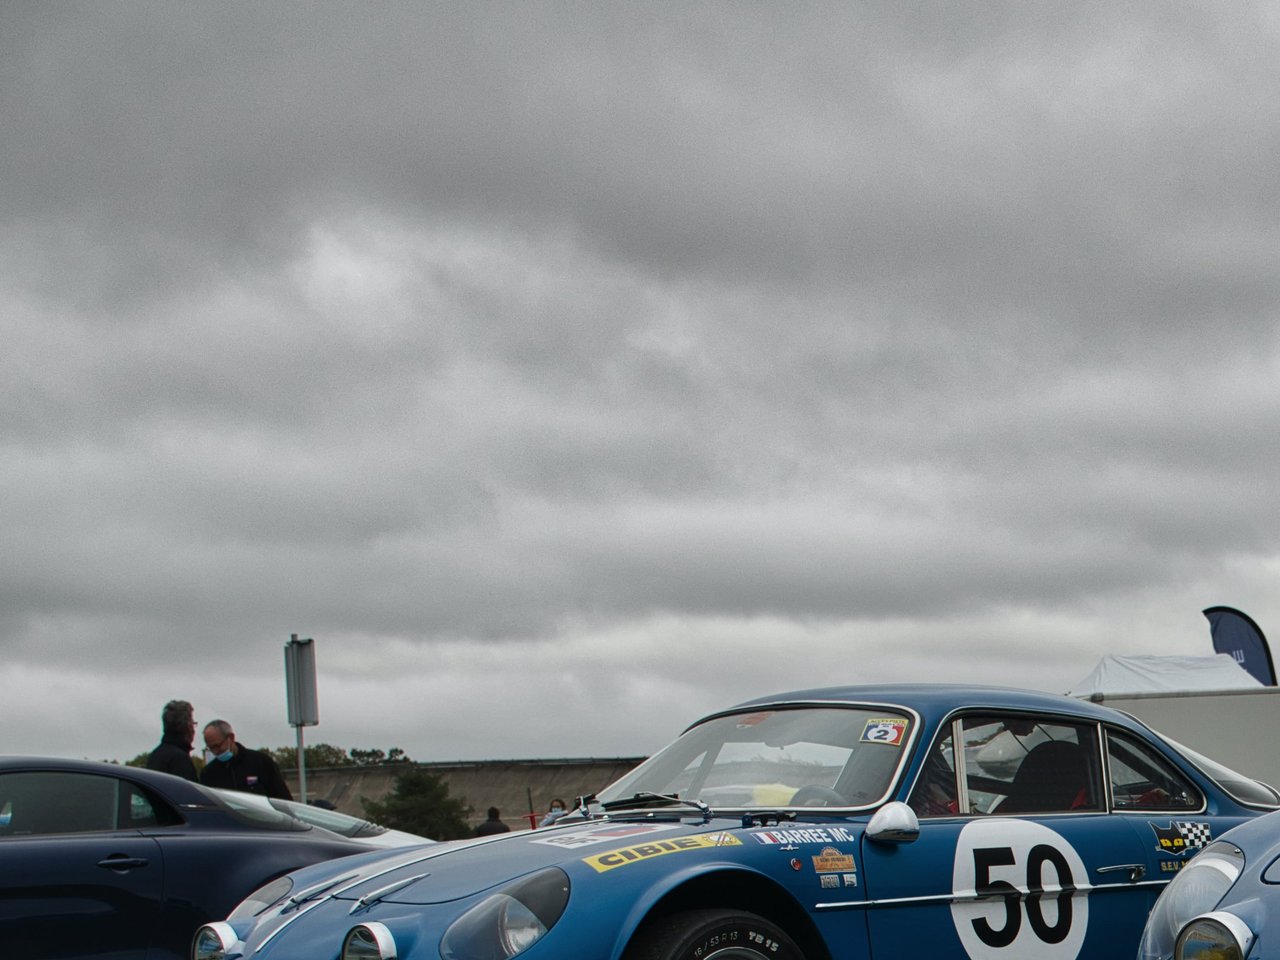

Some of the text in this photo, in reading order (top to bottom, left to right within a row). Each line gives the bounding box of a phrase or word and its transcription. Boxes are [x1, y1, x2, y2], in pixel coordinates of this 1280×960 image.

[874, 729, 889, 740] 2
[771, 827, 854, 844] BARREE MC
[598, 838, 702, 866] CIBIE
[971, 844, 1077, 948] 50
[748, 931, 779, 952] TB 15
